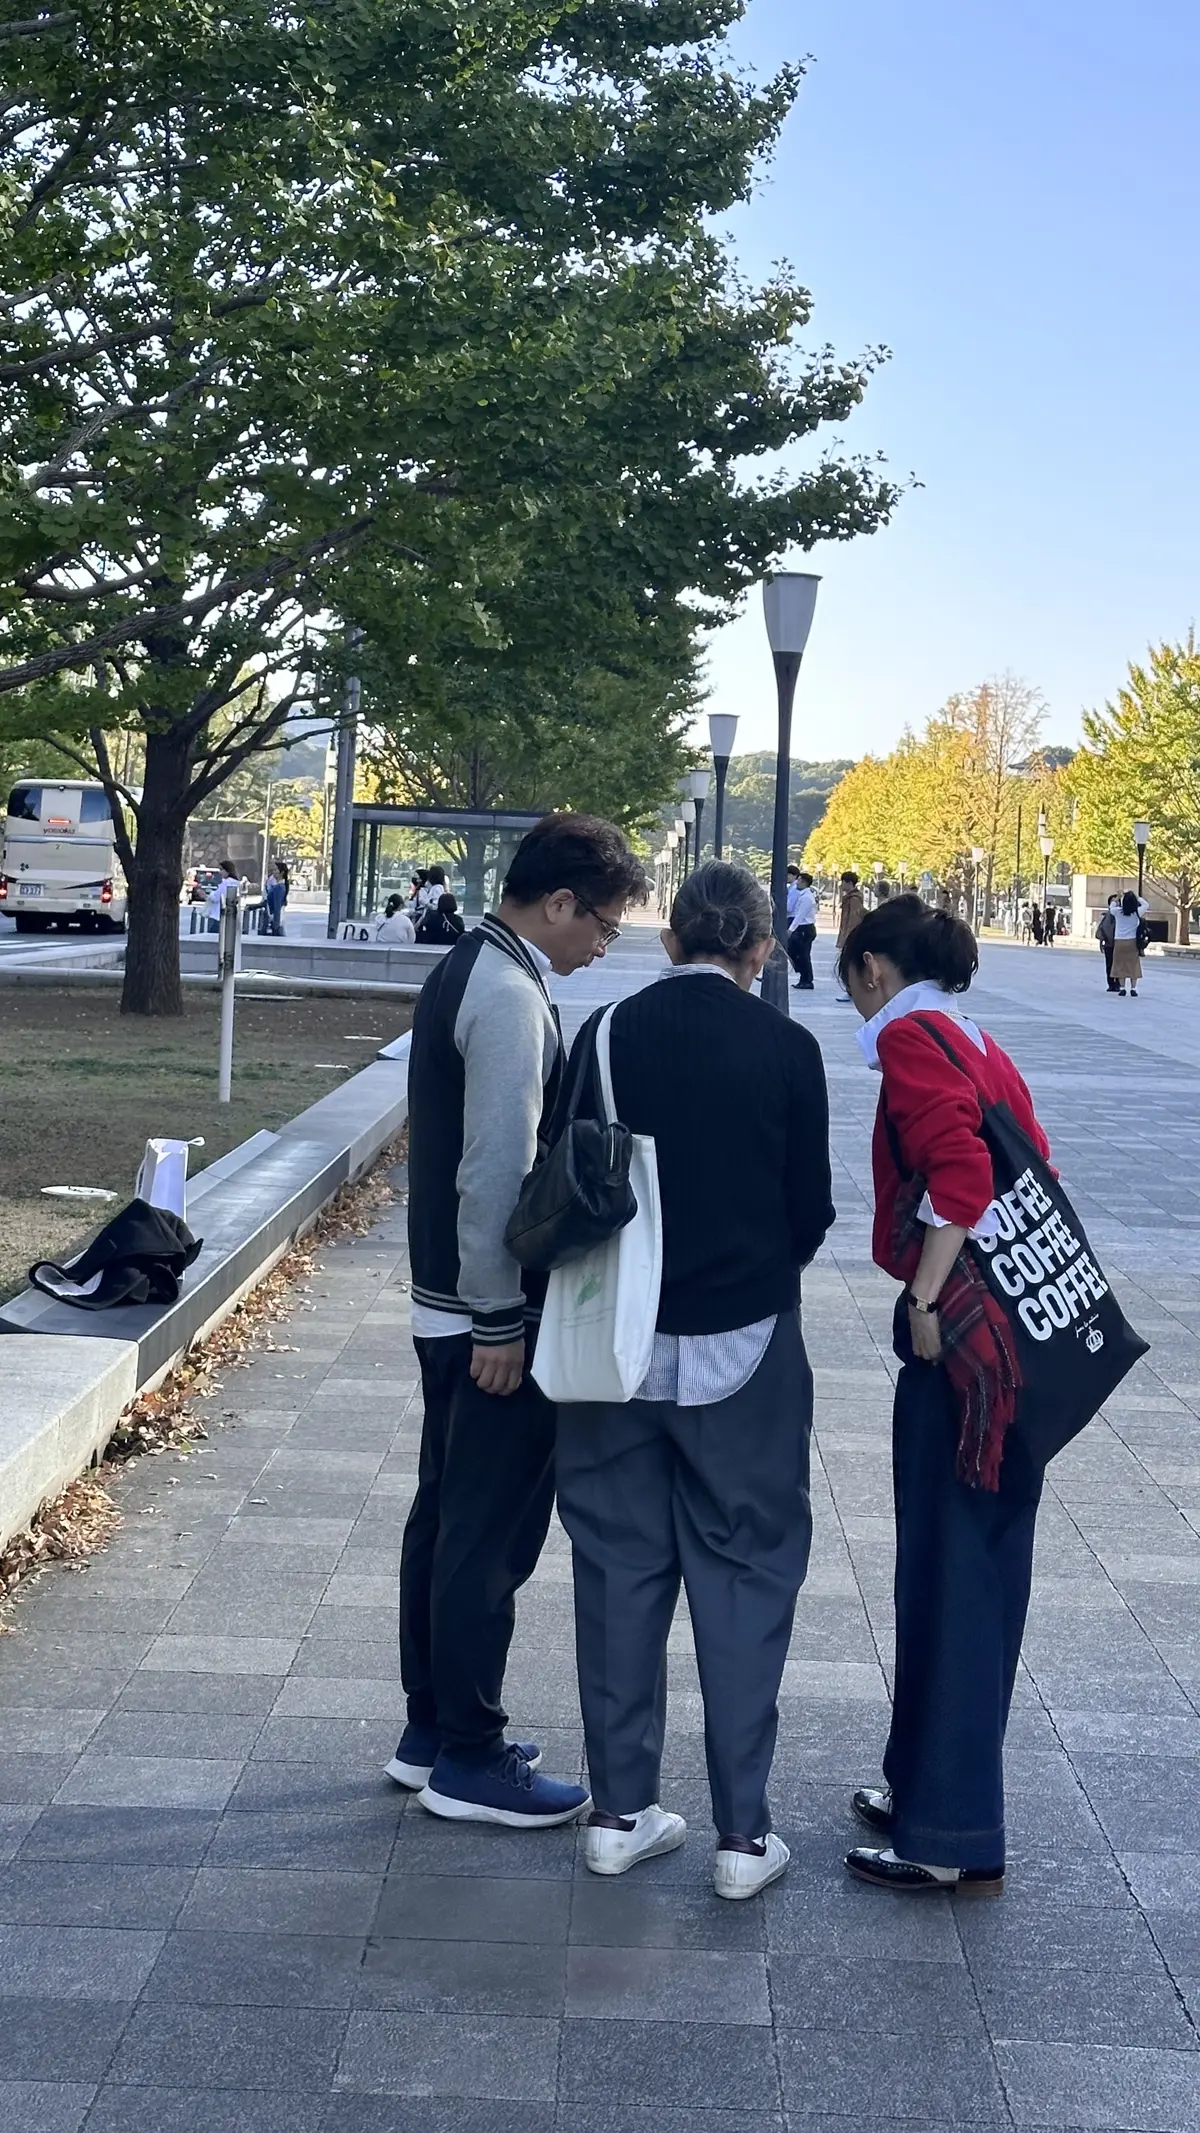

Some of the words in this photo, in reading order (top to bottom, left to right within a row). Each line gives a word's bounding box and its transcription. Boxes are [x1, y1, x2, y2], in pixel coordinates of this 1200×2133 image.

[977, 1167, 1053, 1253] OFFEE
[991, 1209, 1080, 1297] COFFEE
[1017, 1251, 1109, 1341] COFFEE
